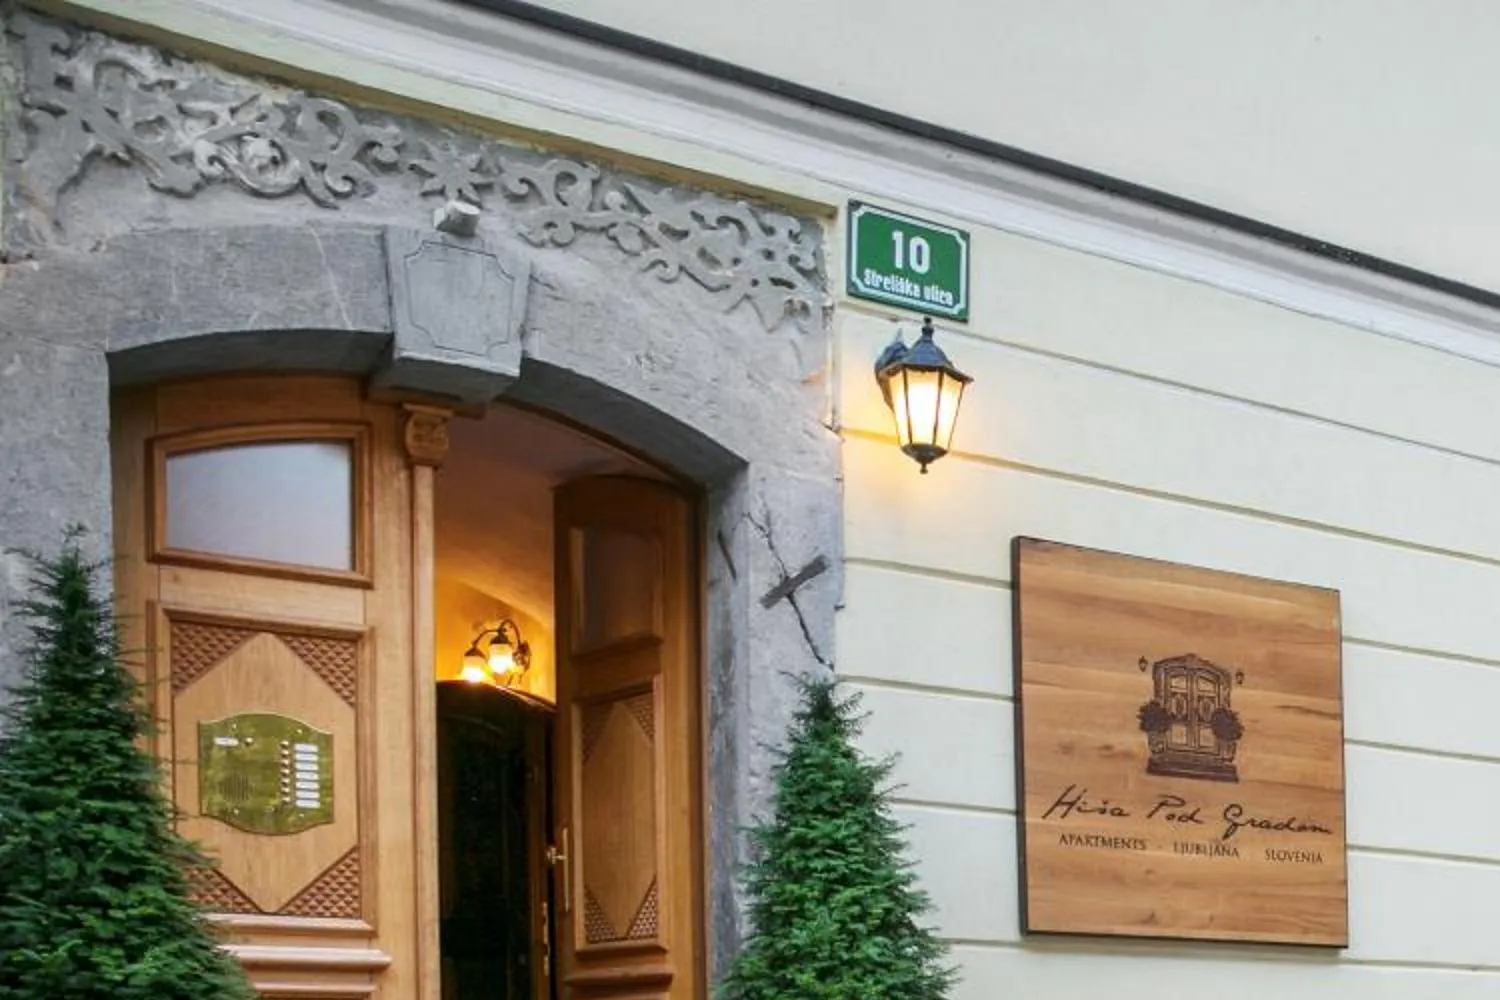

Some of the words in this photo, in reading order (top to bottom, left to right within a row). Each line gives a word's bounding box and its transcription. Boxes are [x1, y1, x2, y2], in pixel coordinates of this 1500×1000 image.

[892, 230, 930, 275] 10
[923, 284, 953, 306] ulica
[1146, 794, 1204, 824] Pod
[1059, 833, 1146, 850] APARTMENTS
[1173, 841, 1240, 859] LJUBLJANA
[1265, 848, 1324, 864] SLOVENIA
